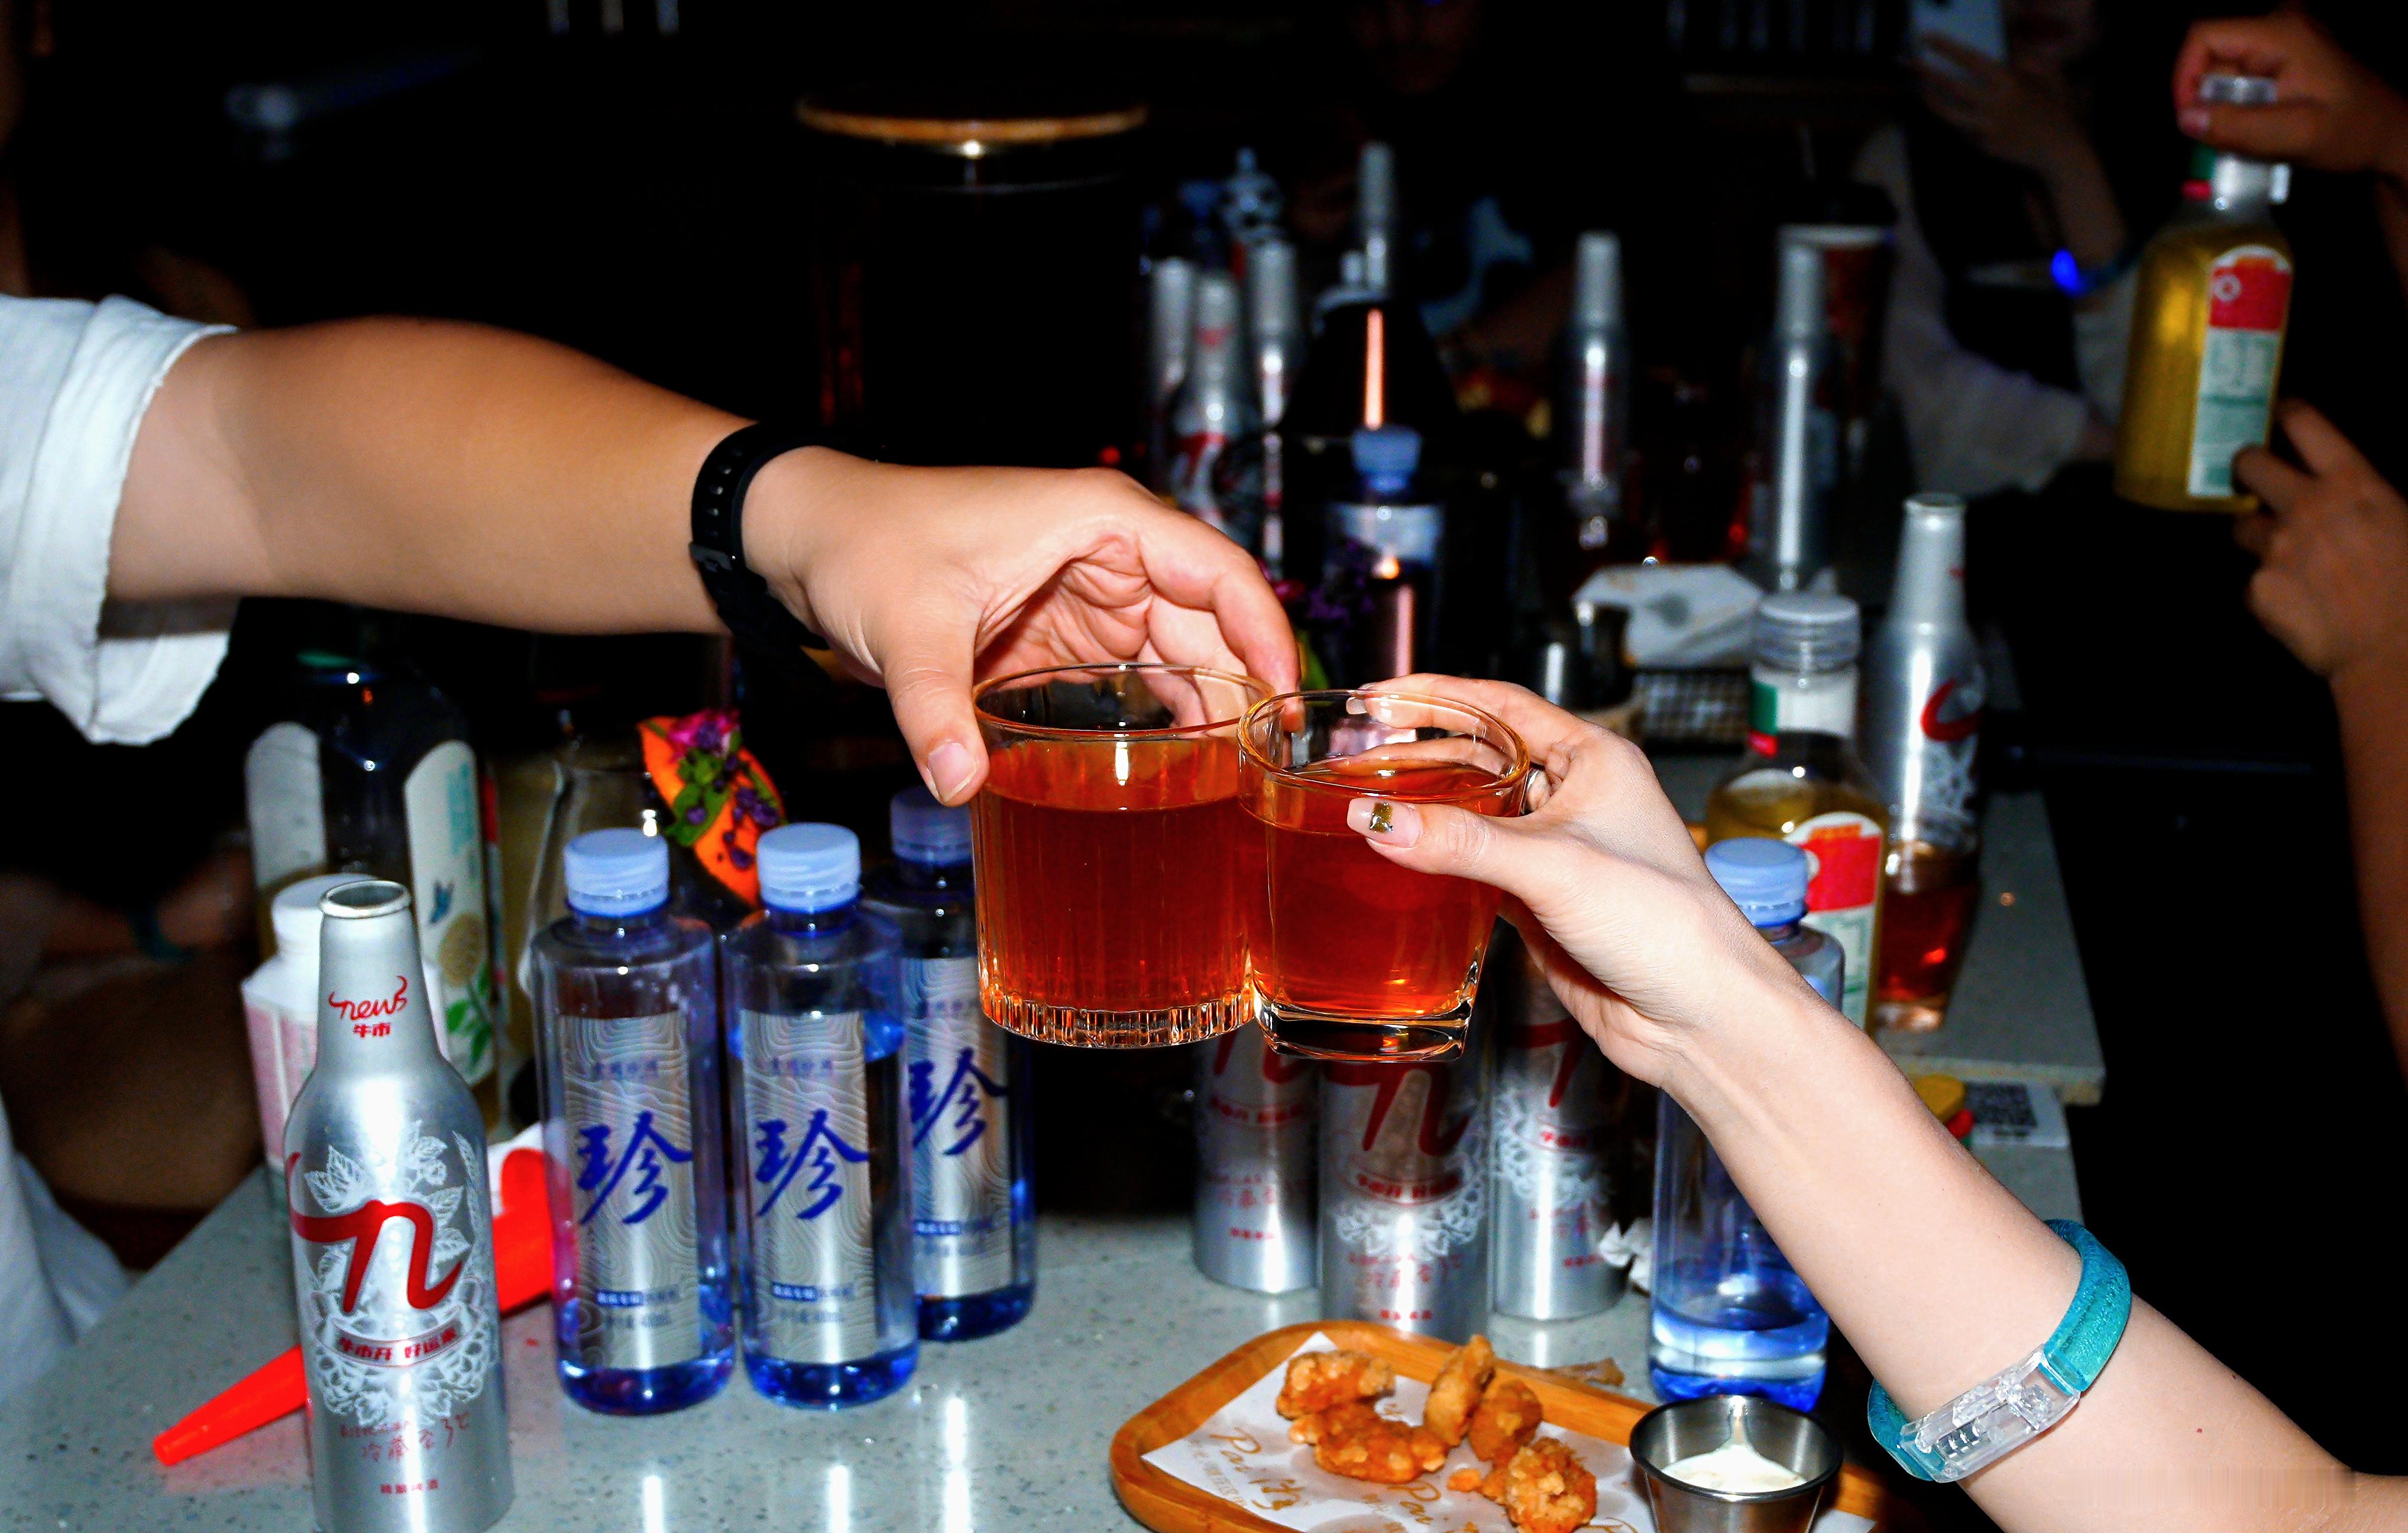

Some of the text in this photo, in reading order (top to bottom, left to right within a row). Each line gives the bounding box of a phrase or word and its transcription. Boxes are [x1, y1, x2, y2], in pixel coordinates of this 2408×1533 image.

[353, 1023, 391, 1037] 牛市
[908, 1046, 1009, 1155] 珍
[577, 1111, 693, 1225] 珍
[756, 1109, 869, 1220] 珍
